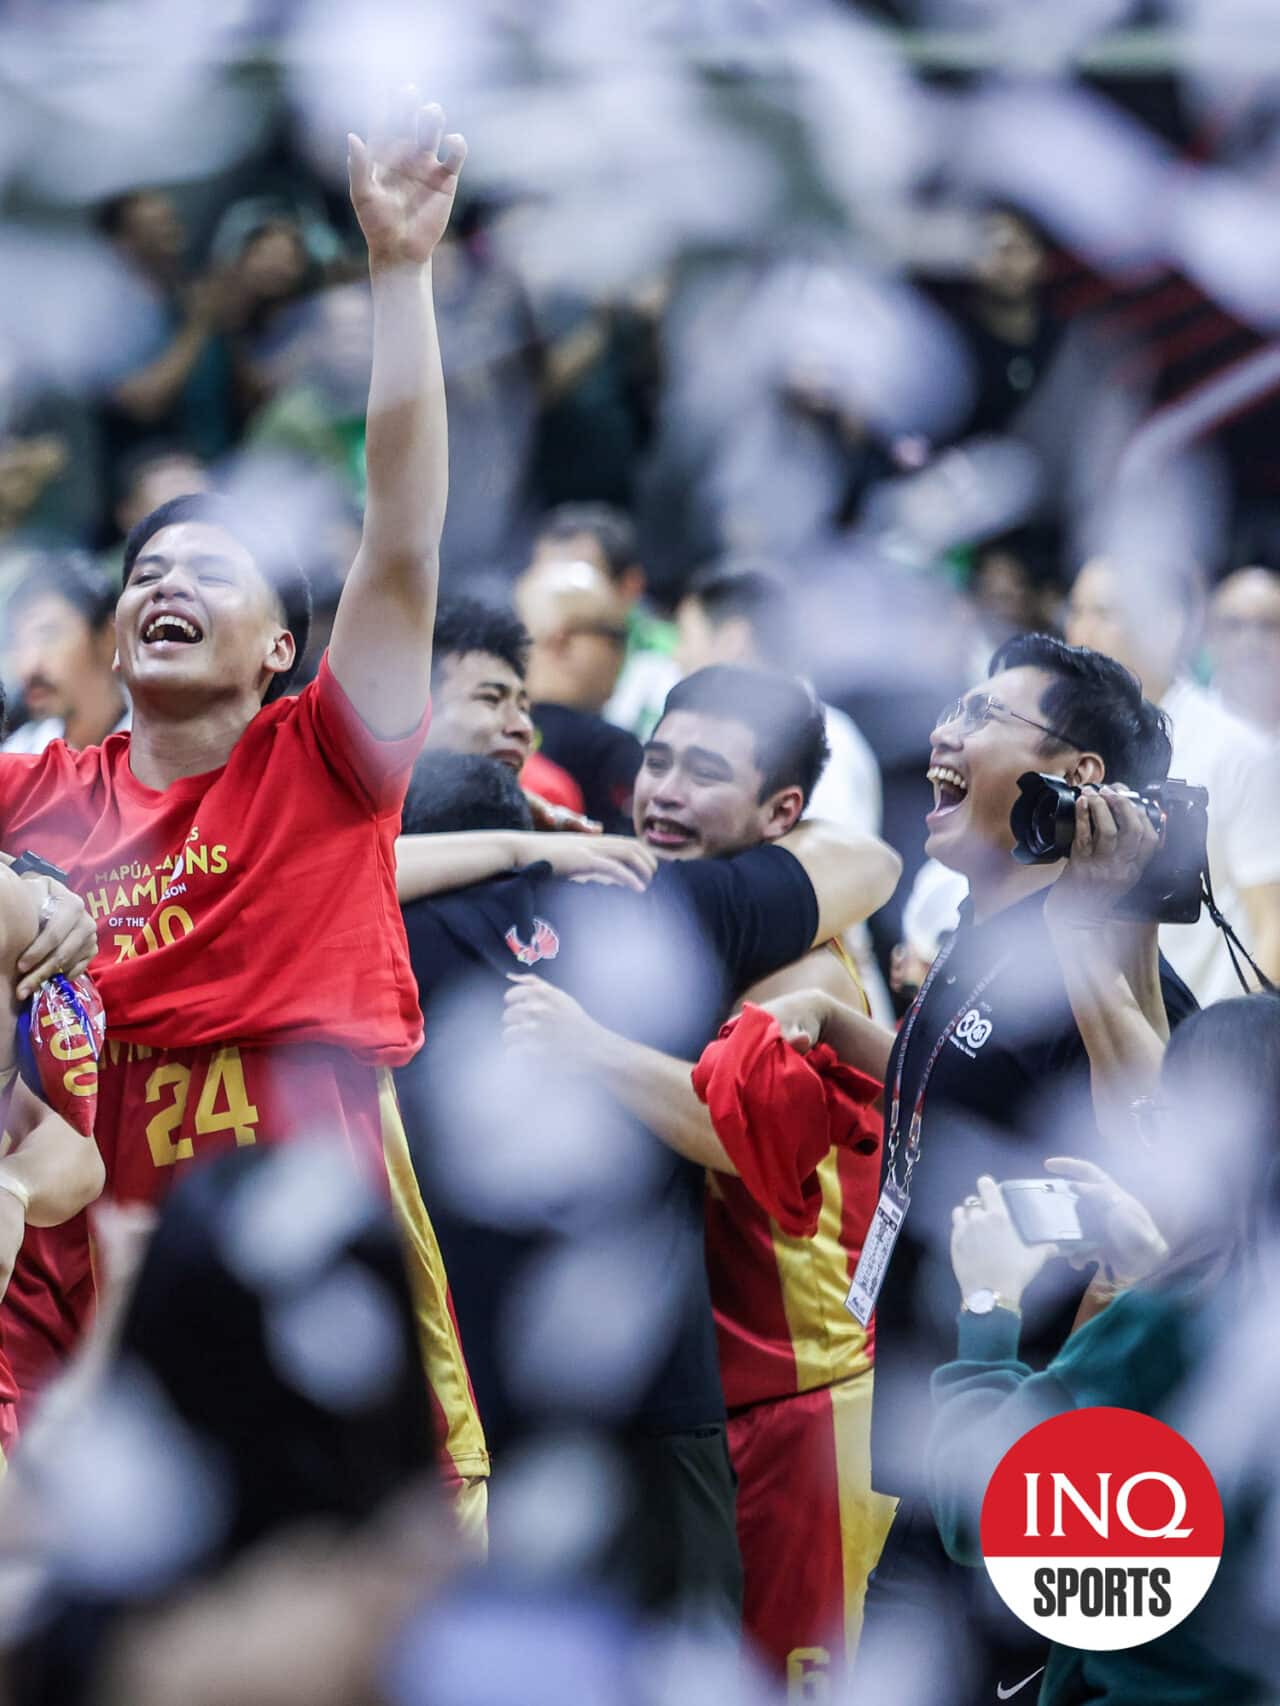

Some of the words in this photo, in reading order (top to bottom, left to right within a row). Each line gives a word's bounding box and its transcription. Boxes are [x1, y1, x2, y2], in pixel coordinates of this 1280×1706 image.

[108, 917, 124, 928] OF
[126, 916, 145, 928] THE
[145, 1046, 259, 1167] 24
